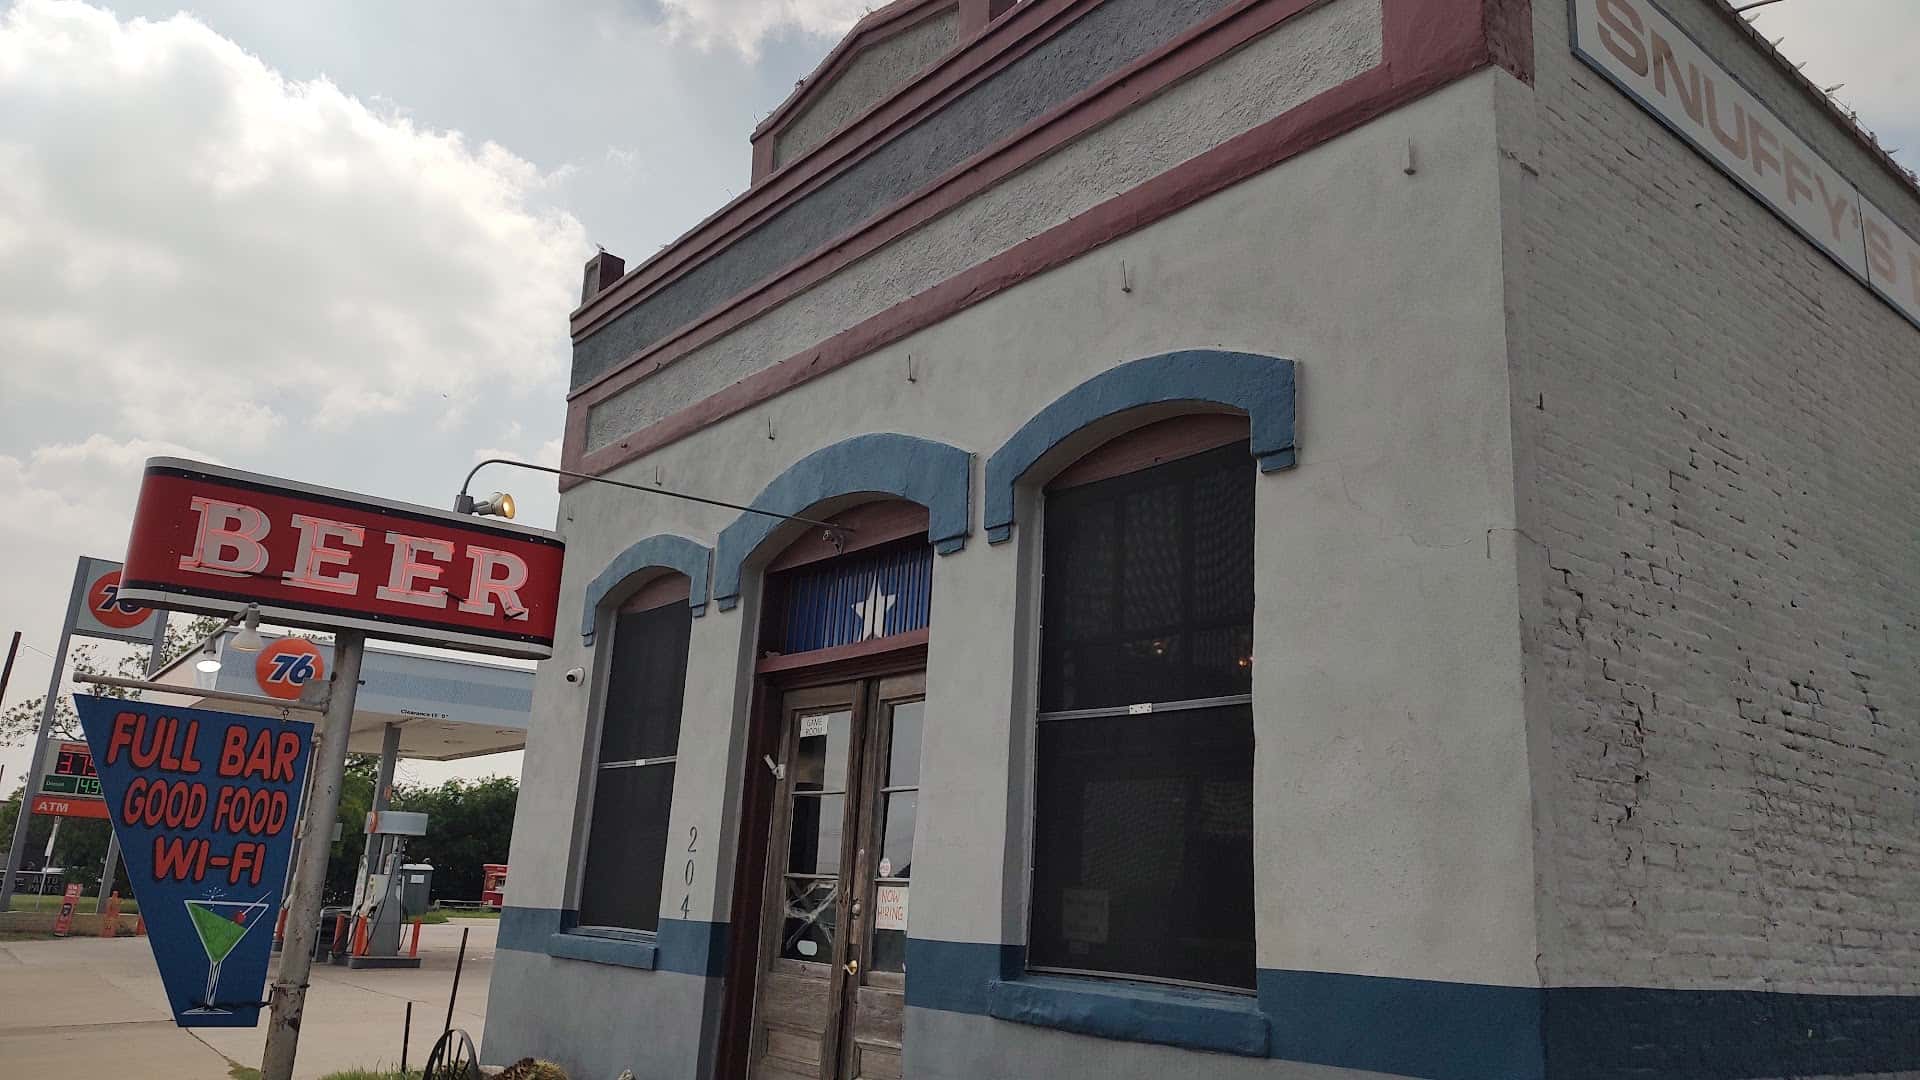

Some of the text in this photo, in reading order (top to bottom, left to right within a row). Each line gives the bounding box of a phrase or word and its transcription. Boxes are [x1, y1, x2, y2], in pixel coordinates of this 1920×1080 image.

[1596, 0, 1896, 284] SNUFFY'S
[178, 495, 530, 621] BEER
[266, 652, 316, 687] 76
[400, 708, 430, 717] Clearance
[806, 717, 823, 727] GAME
[106, 711, 301, 783] FULL BAR
[805, 726, 824, 737] ROOM
[38, 801, 69, 813] ATM
[122, 776, 289, 836] GOOD FOOD
[153, 835, 267, 886] WI-FI
[680, 826, 698, 920] 204
[878, 904, 904, 921] HIRING
[880, 888, 900, 904] NOW
